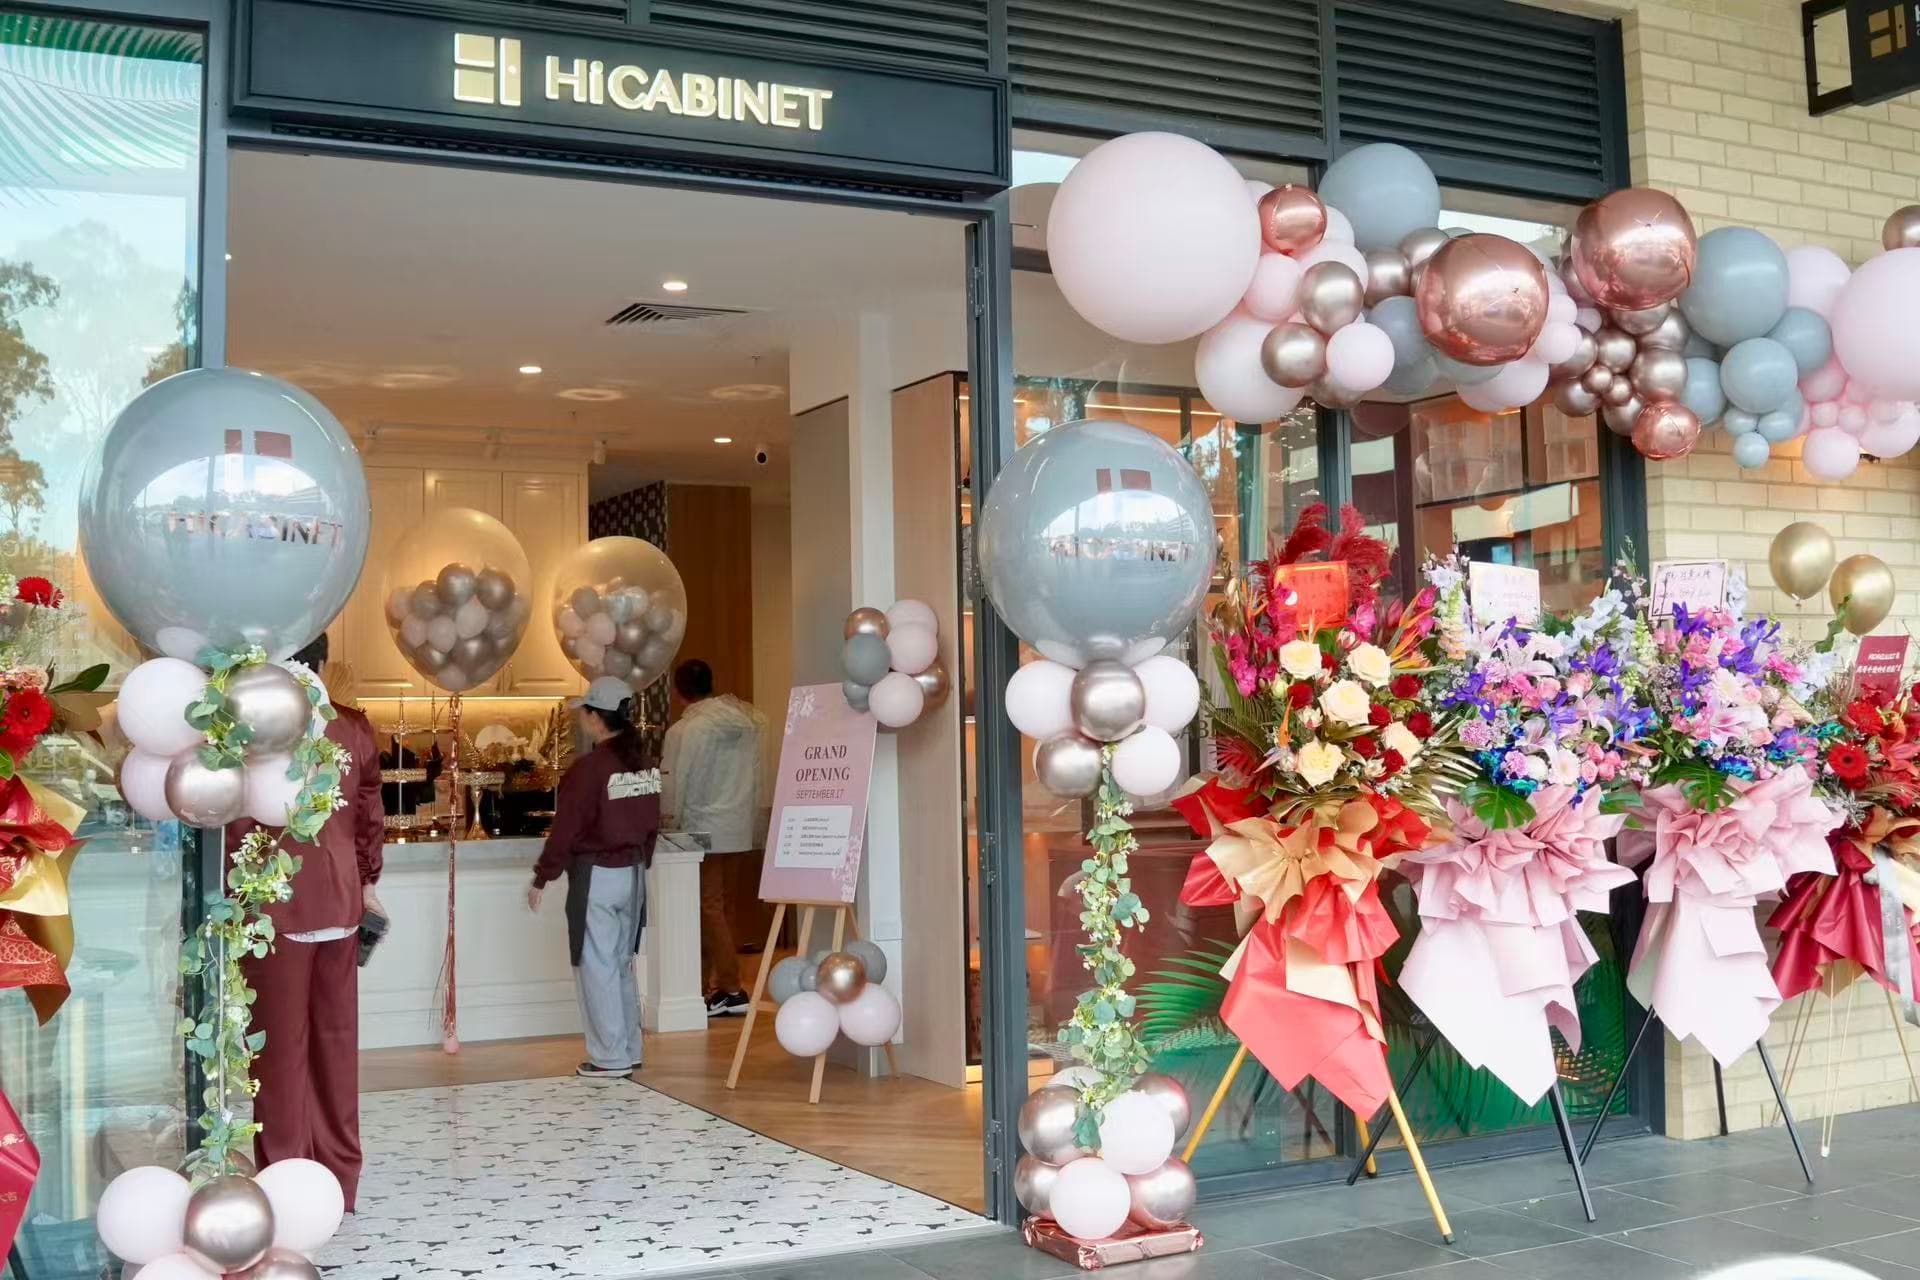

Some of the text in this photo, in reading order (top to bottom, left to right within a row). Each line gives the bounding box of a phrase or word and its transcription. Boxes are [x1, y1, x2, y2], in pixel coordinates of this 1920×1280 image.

[804, 744, 847, 761] GRAND
[795, 766, 850, 782] OPENING
[795, 788, 835, 800] SEPTEMBER
